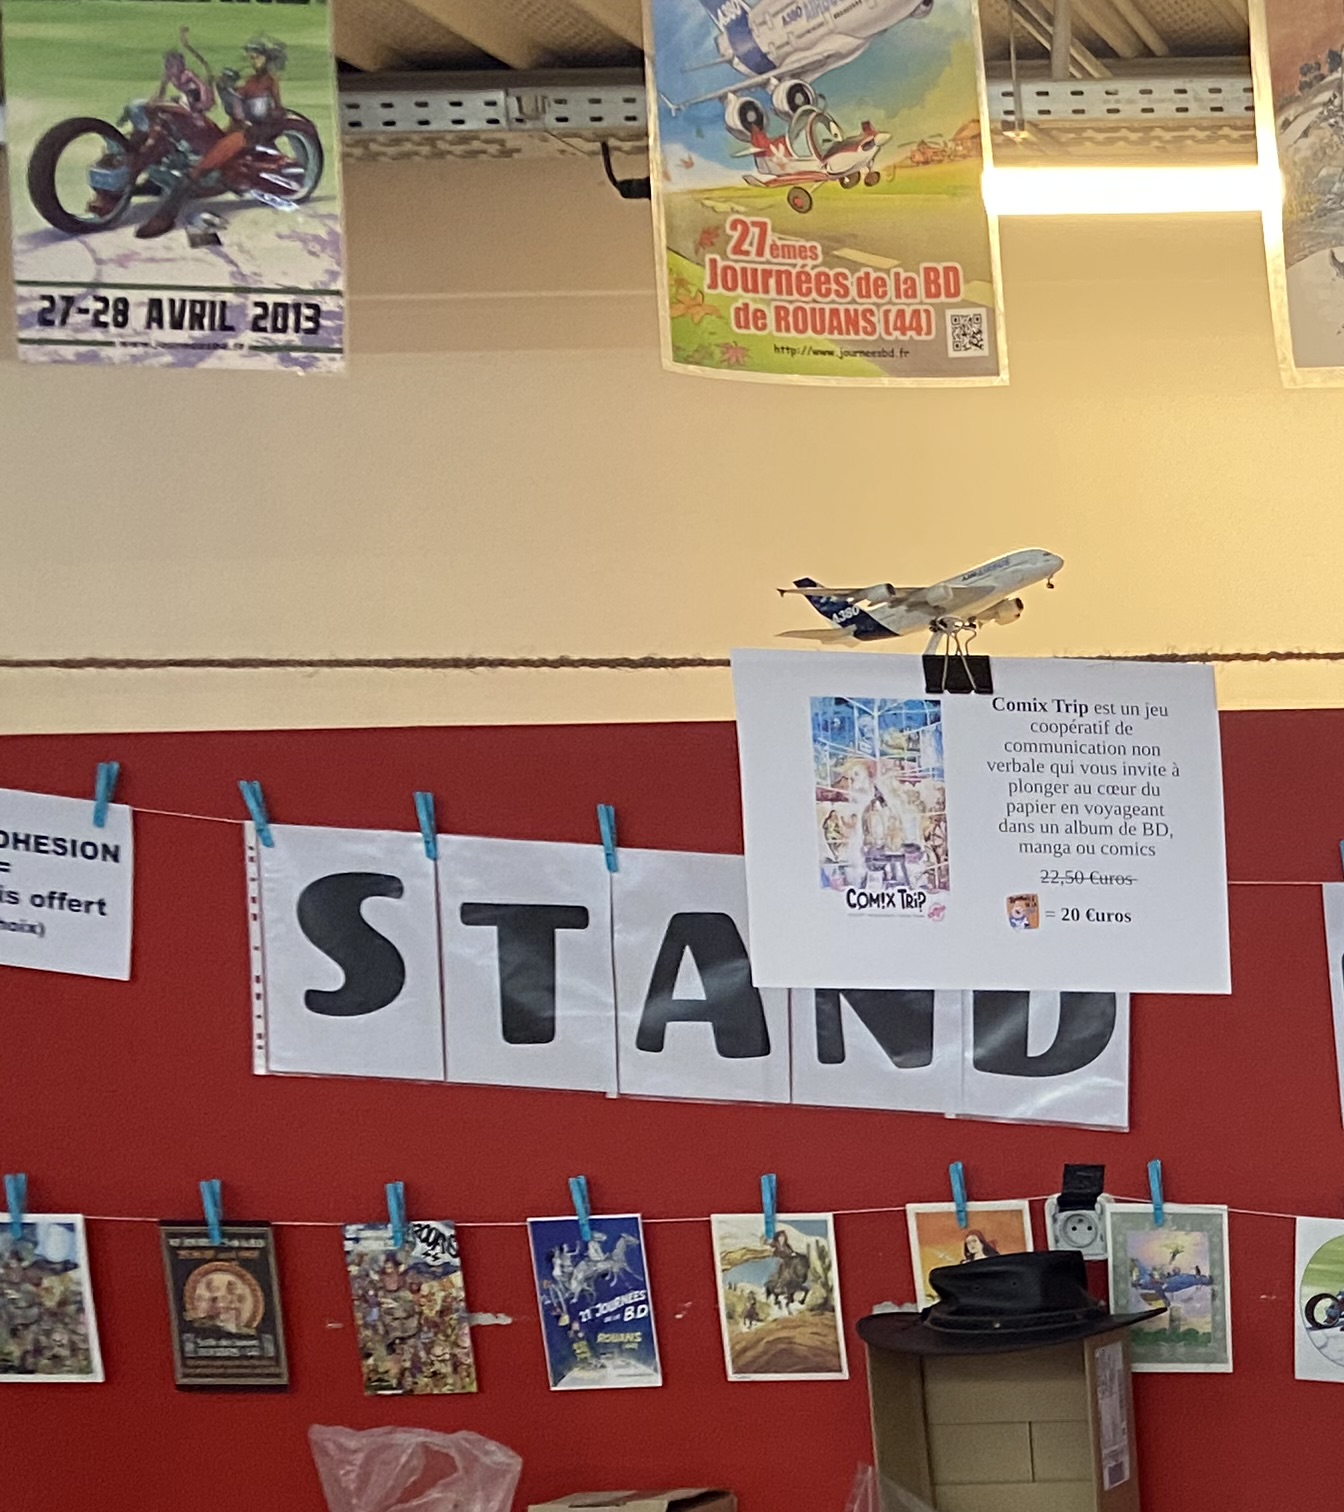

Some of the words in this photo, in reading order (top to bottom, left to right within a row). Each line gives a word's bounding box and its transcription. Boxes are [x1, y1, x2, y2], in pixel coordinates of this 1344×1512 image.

[707, 257, 850, 299] Journées
[856, 271, 888, 299] de
[894, 268, 918, 299] la
[921, 265, 962, 299] BD
[37, 295, 130, 329] 27-28
[146, 298, 235, 332] AVRIL
[251, 301, 322, 335] 2013
[733, 302, 768, 331] de
[774, 304, 877, 337] ROUANS
[883, 307, 934, 337] (44)
[992, 697, 1048, 716] Comix
[1052, 699, 1089, 719] Trip
[1094, 702, 1117, 716] est
[1121, 705, 1140, 717] un
[1144, 702, 1169, 720] jeu
[1030, 719, 1110, 740] coopératif
[1115, 721, 1134, 736] de
[1004, 739, 1127, 757] communication
[1132, 745, 1161, 757] non
[987, 757, 1046, 774] verbale
[1050, 761, 1075, 780] qui
[1080, 765, 1118, 777] vous
[1121, 761, 1168, 778] invite
[1171, 762, 1181, 777] à
[1008, 779, 1069, 799] plonger
[1074, 783, 1093, 796] au
[1096, 784, 1136, 797] cœur
[1141, 781, 1161, 797] du
[1006, 800, 1056, 820] papier
[1060, 804, 1080, 816] en
[1084, 804, 1165, 822] voyageant
[998, 817, 1036, 835] dans
[1040, 823, 1060, 835] un
[1064, 819, 1114, 836] album
[1118, 821, 1138, 837] de
[1142, 822, 1174, 841] BD,
[1018, 842, 1071, 859] manga
[1076, 844, 1096, 856] ou
[1100, 841, 1156, 858] comics
[1040, 869, 1085, 887] 22,50
[30, 890, 107, 916] offert
[1061, 908, 1081, 922] 20
